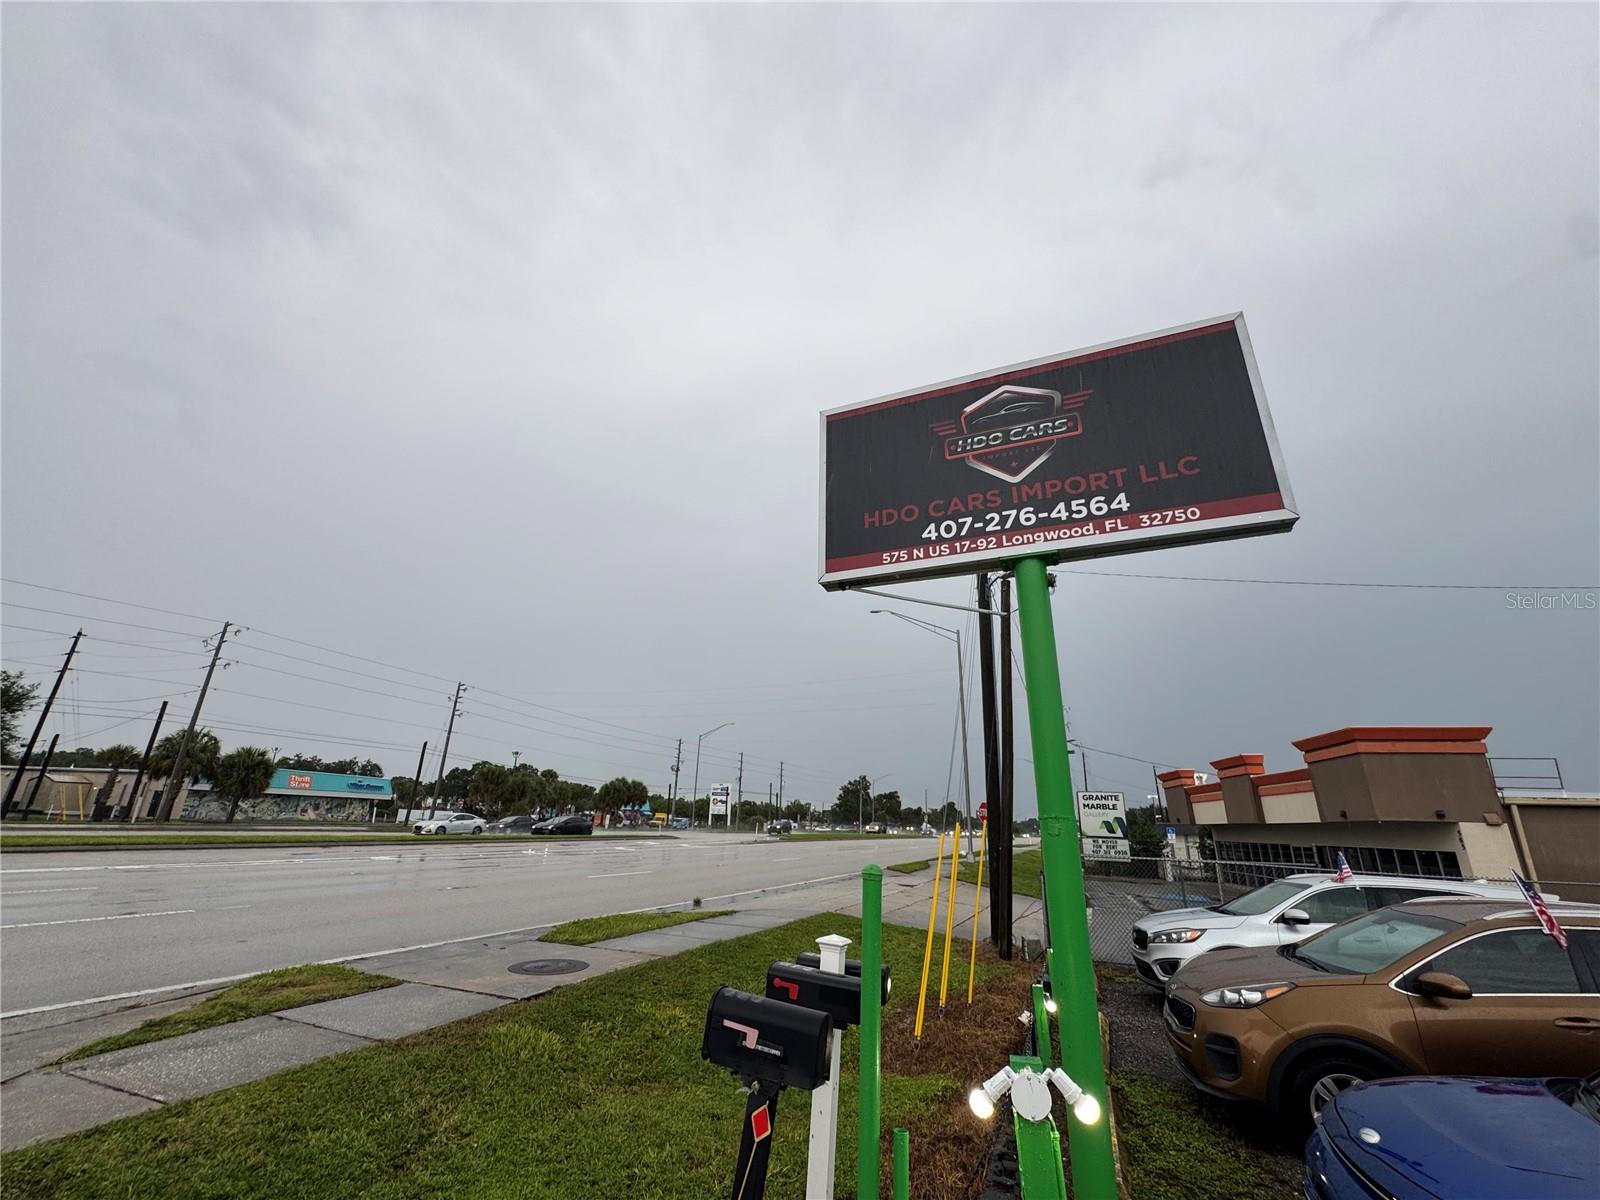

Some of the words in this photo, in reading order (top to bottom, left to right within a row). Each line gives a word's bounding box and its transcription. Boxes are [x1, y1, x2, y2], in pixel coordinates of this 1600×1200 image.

[956, 432, 1003, 452] HDO
[1009, 418, 1068, 441] CARS
[863, 504, 920, 529] HDO
[927, 489, 1001, 517] CARS
[1010, 468, 1128, 504] IMPORT
[1138, 455, 1201, 483] LLC
[921, 492, 1131, 541] 407-276-4564
[882, 550, 908, 564] 575
[913, 547, 924, 560] N
[929, 544, 950, 557] US
[954, 537, 998, 554] 17-92
[1002, 522, 1101, 544] Longwood,
[1104, 518, 1129, 532] FL
[1138, 507, 1201, 527] 32750
[289, 780, 311, 788] Store
